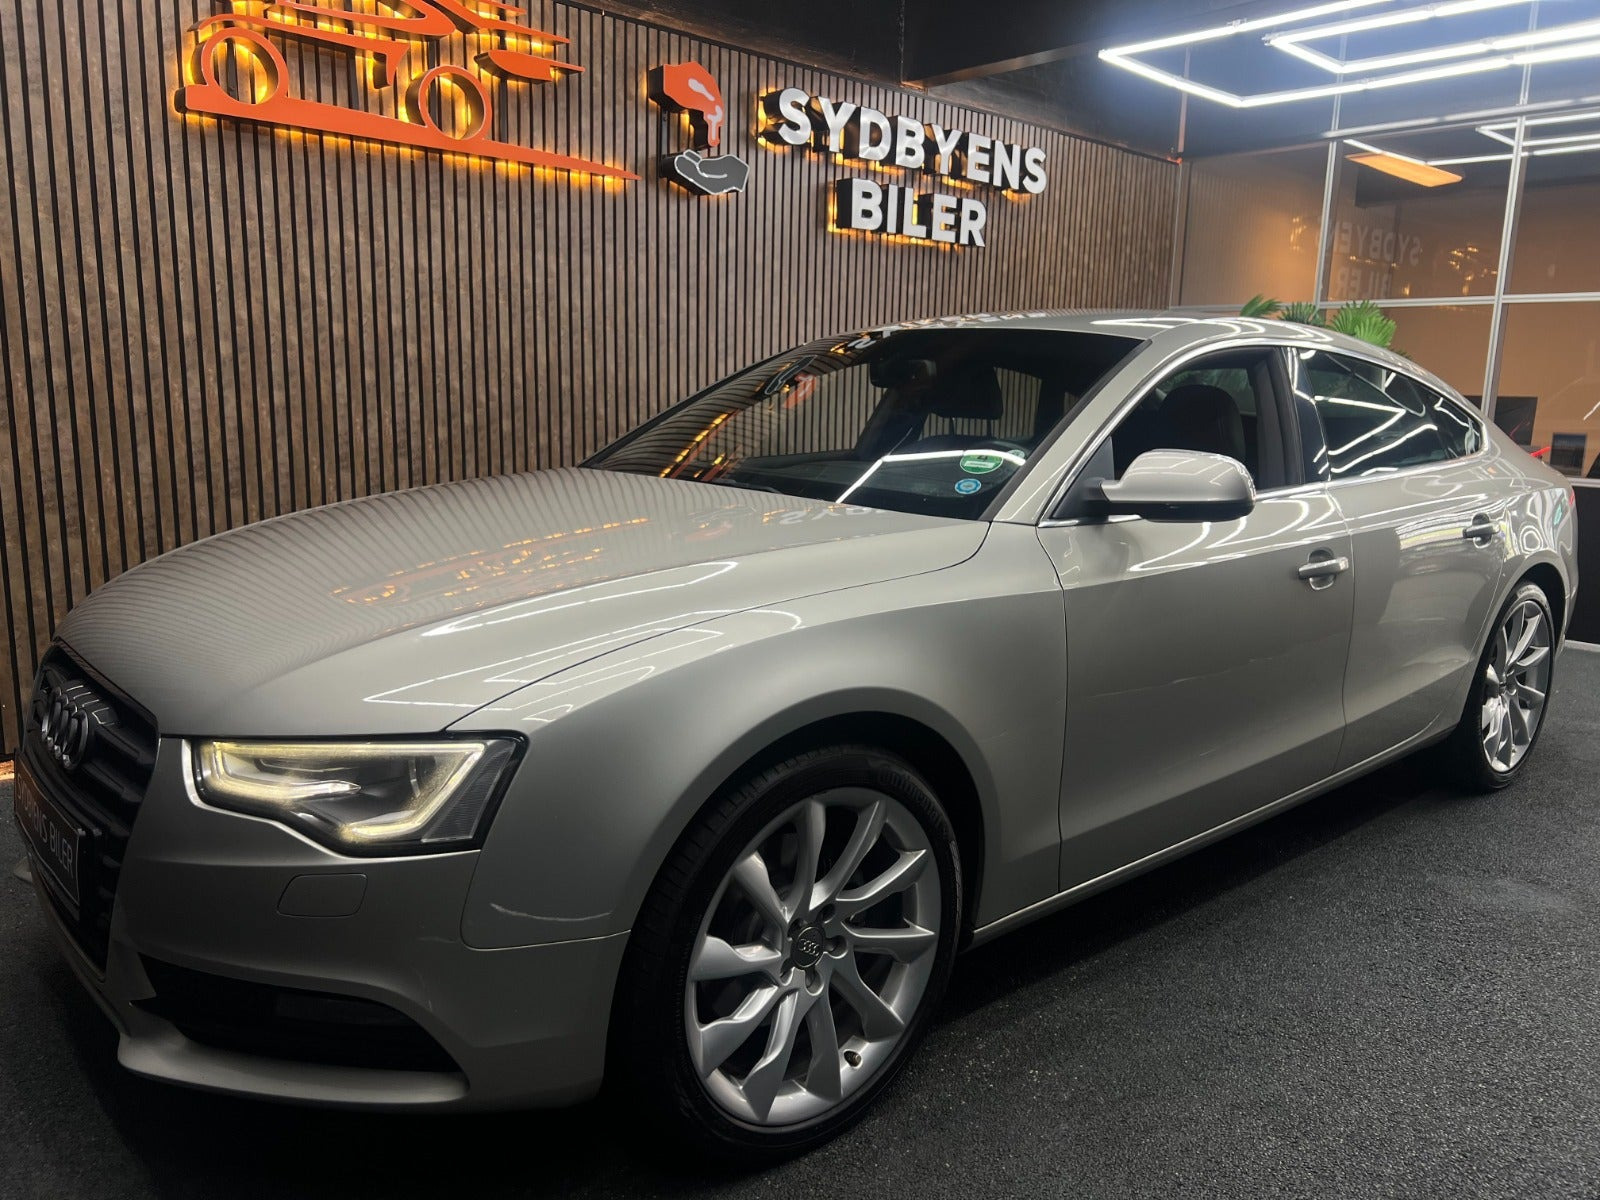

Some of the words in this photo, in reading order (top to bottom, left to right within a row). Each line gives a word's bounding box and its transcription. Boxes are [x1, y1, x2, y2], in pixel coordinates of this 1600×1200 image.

[776, 86, 1048, 195] SYDBYENS
[850, 177, 986, 248] BILER
[49, 822, 73, 878] BILER
